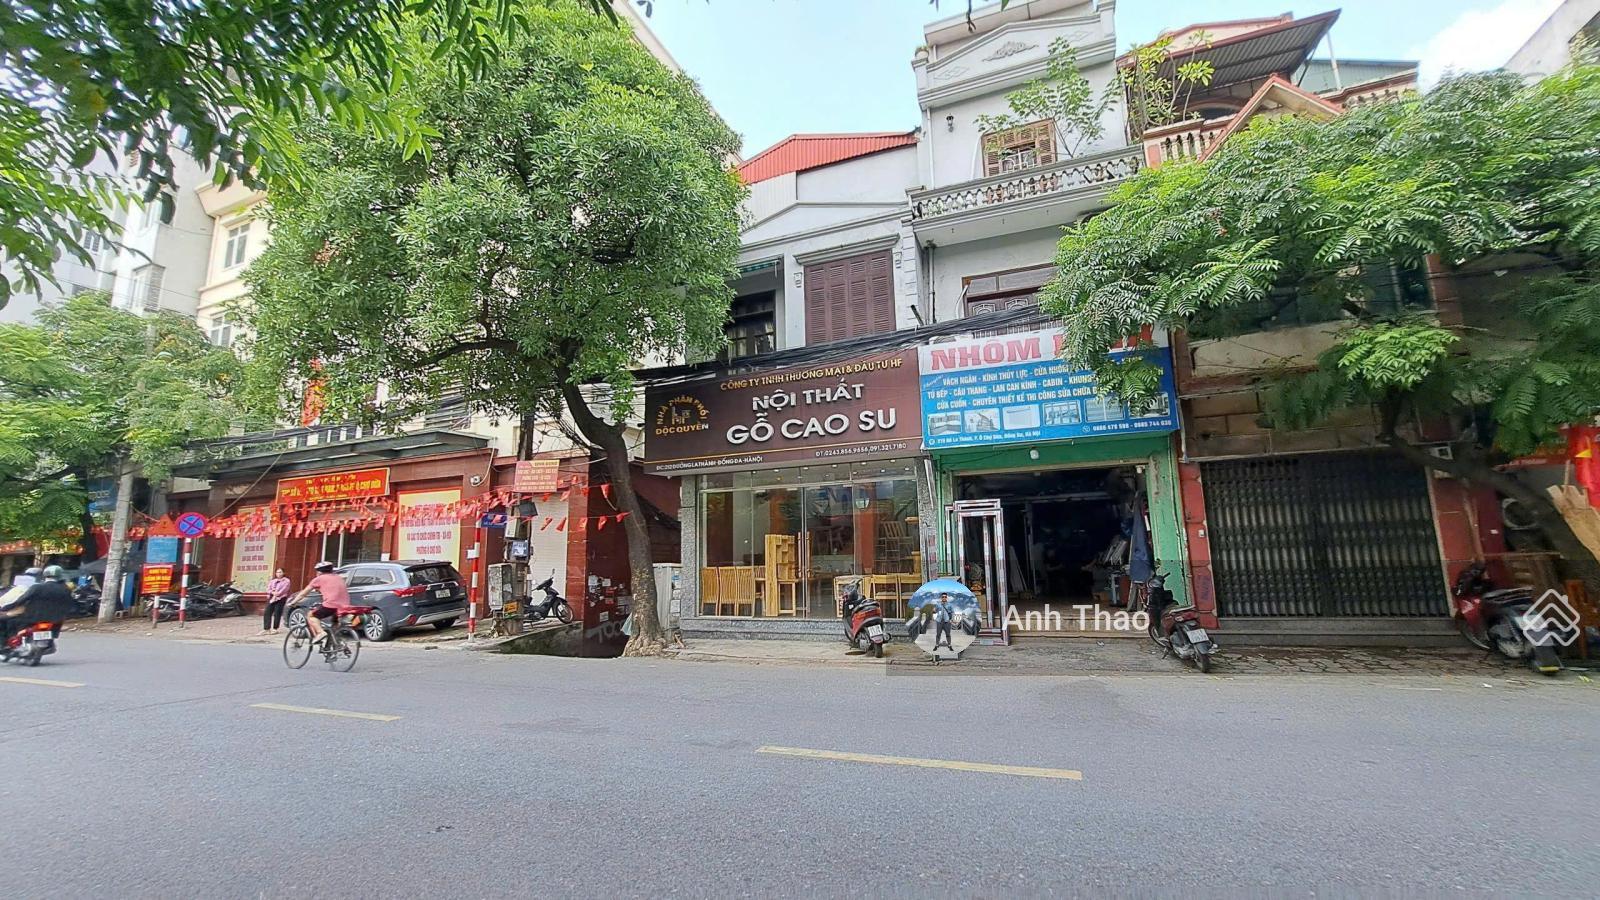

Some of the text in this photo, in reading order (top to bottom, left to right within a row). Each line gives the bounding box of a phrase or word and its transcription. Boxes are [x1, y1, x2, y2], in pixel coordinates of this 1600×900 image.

[931, 337, 1042, 370] NHÔM
[720, 378, 748, 390] CÔNG
[749, 378, 760, 386] TY
[761, 375, 784, 384] TNHH
[784, 370, 824, 382] THƯƠNG
[824, 366, 845, 378] MẠI
[854, 362, 875, 373] ĐẦU
[875, 360, 890, 370] TƯ
[890, 358, 902, 368] HF
[752, 378, 865, 412] NỘI THẤT
[726, 408, 898, 445] GỖ CAO SU
